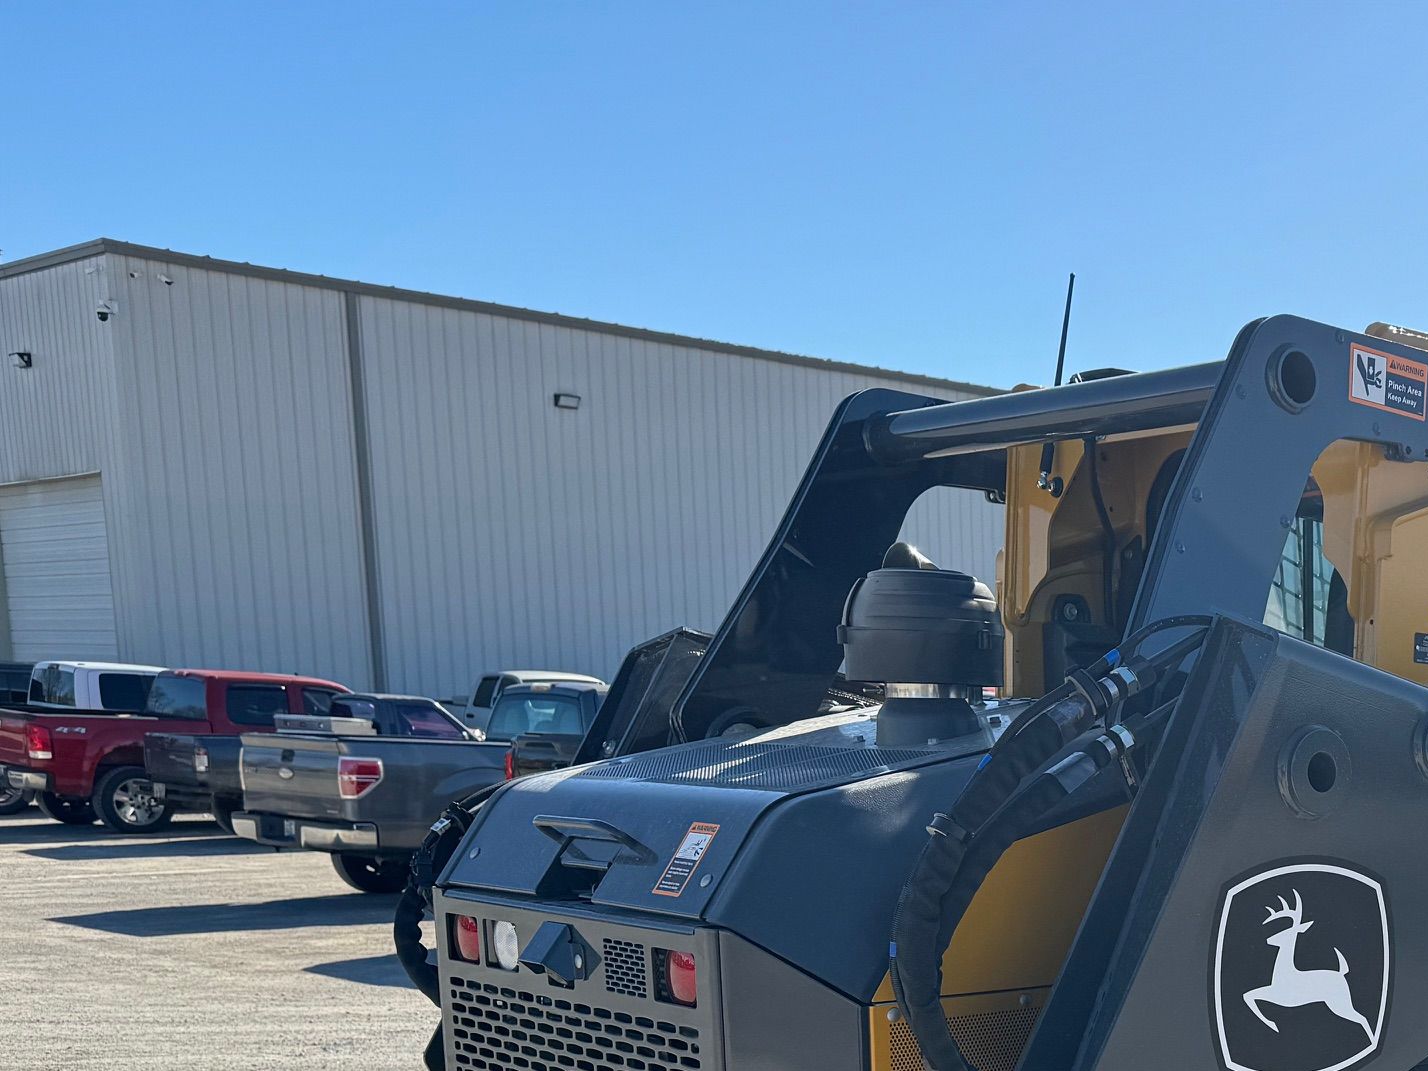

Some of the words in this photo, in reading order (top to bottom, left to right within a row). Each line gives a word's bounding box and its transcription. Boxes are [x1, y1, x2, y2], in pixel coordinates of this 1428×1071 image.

[1396, 362, 1424, 377] WARNING
[1388, 379, 1406, 393] Pinch
[1407, 385, 1422, 397] Area
[1387, 392, 1402, 404] Keep
[1402, 396, 1417, 408] Away
